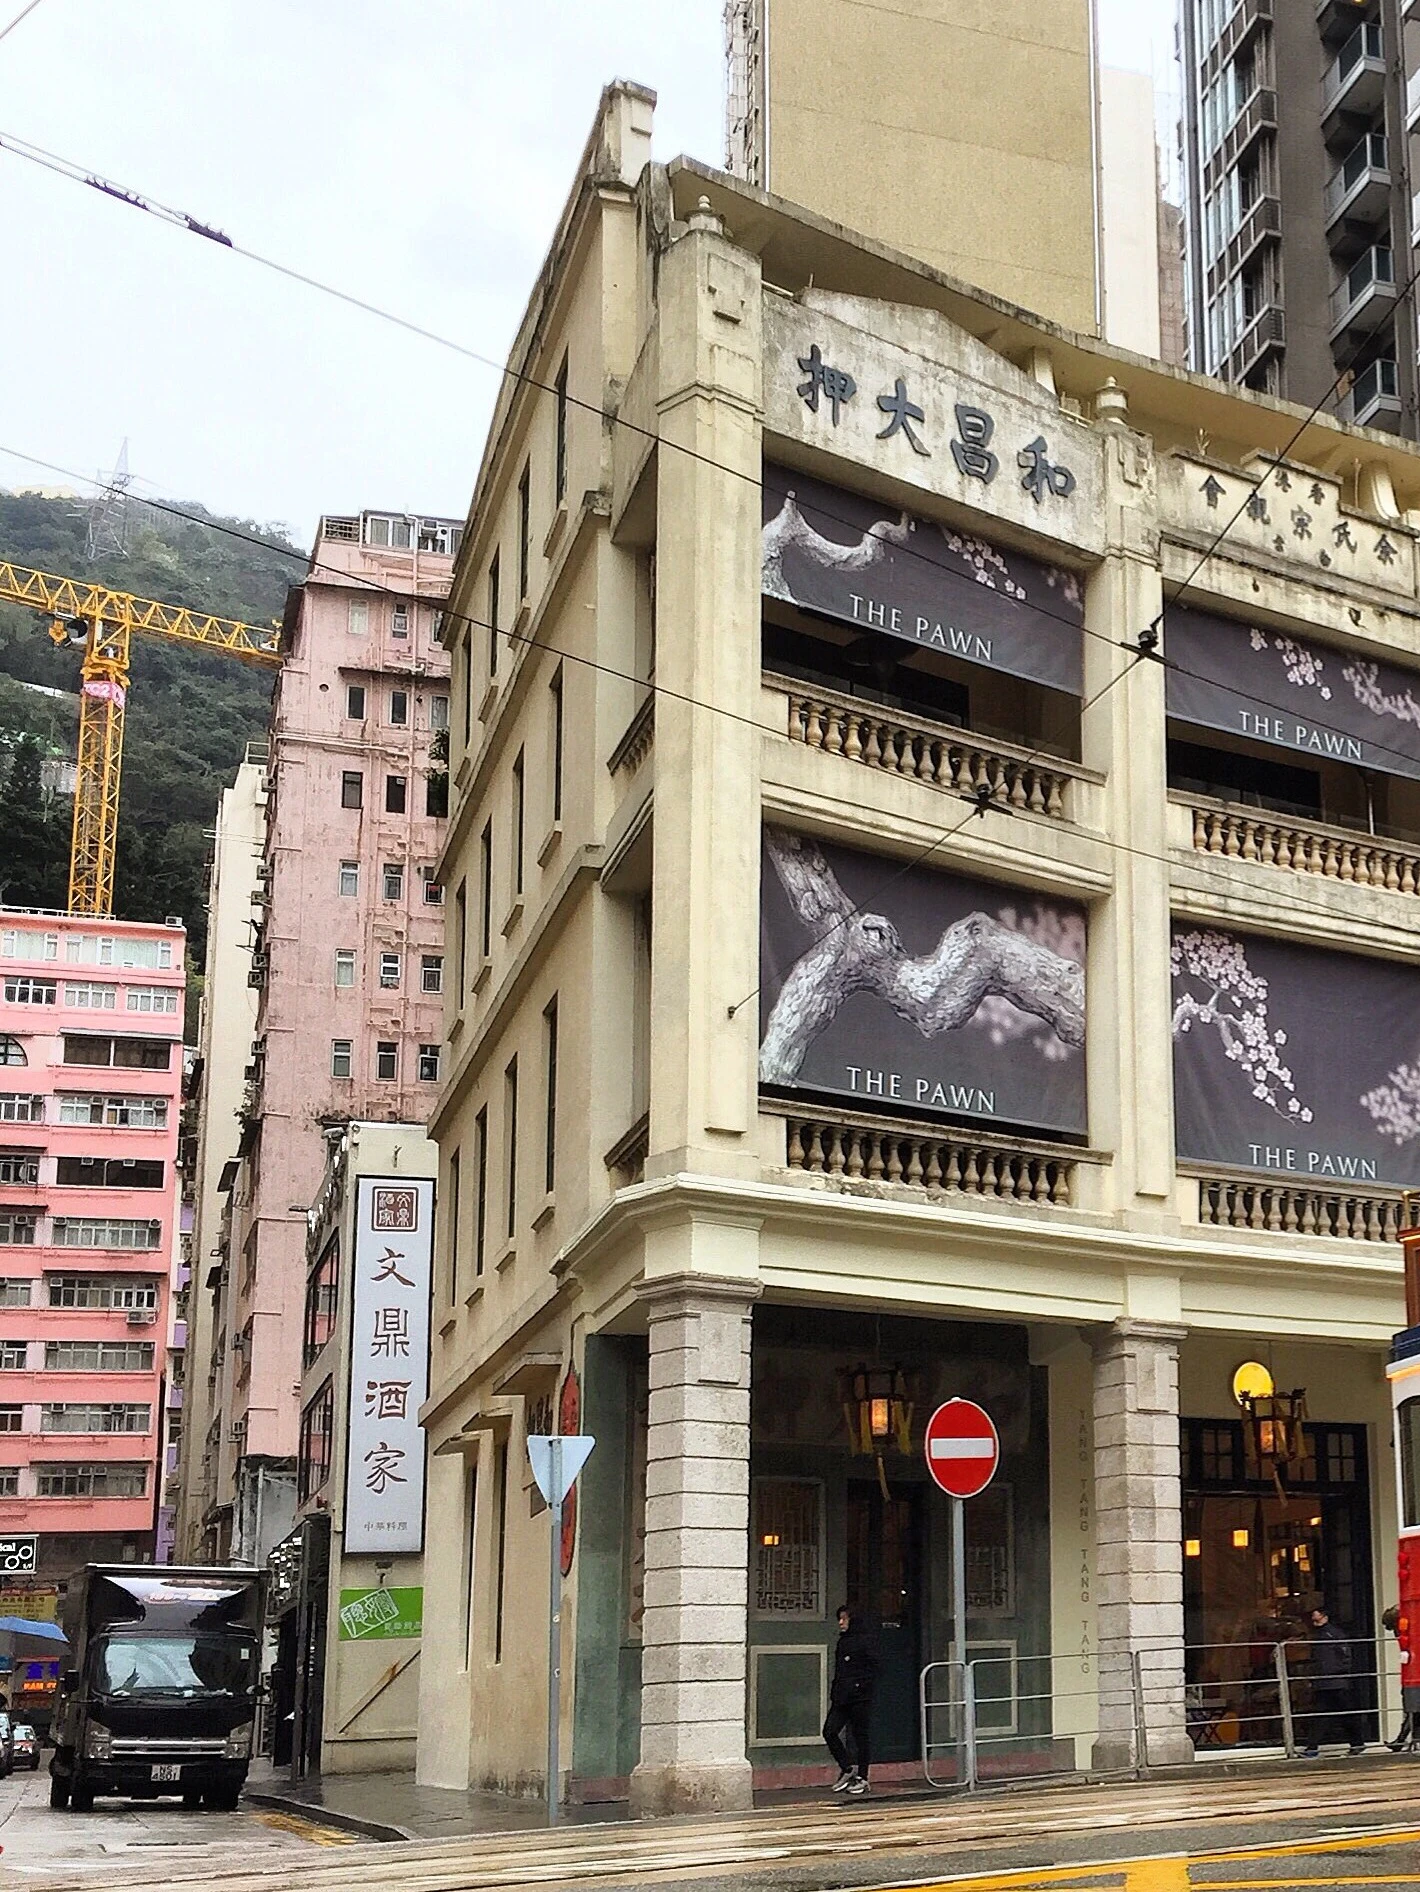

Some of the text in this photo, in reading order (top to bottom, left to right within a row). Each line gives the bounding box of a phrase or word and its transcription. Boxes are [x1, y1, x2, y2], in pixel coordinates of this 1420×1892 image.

[849, 593, 992, 661] THE PAWN
[1239, 710, 1361, 759] THE PAWN
[846, 1066, 994, 1114] THE PAWN
[1248, 1143, 1376, 1179] THE PAWN
[363, 1246, 416, 1494] 文鼎酒家
[1081, 1549, 1090, 1603] TANG
